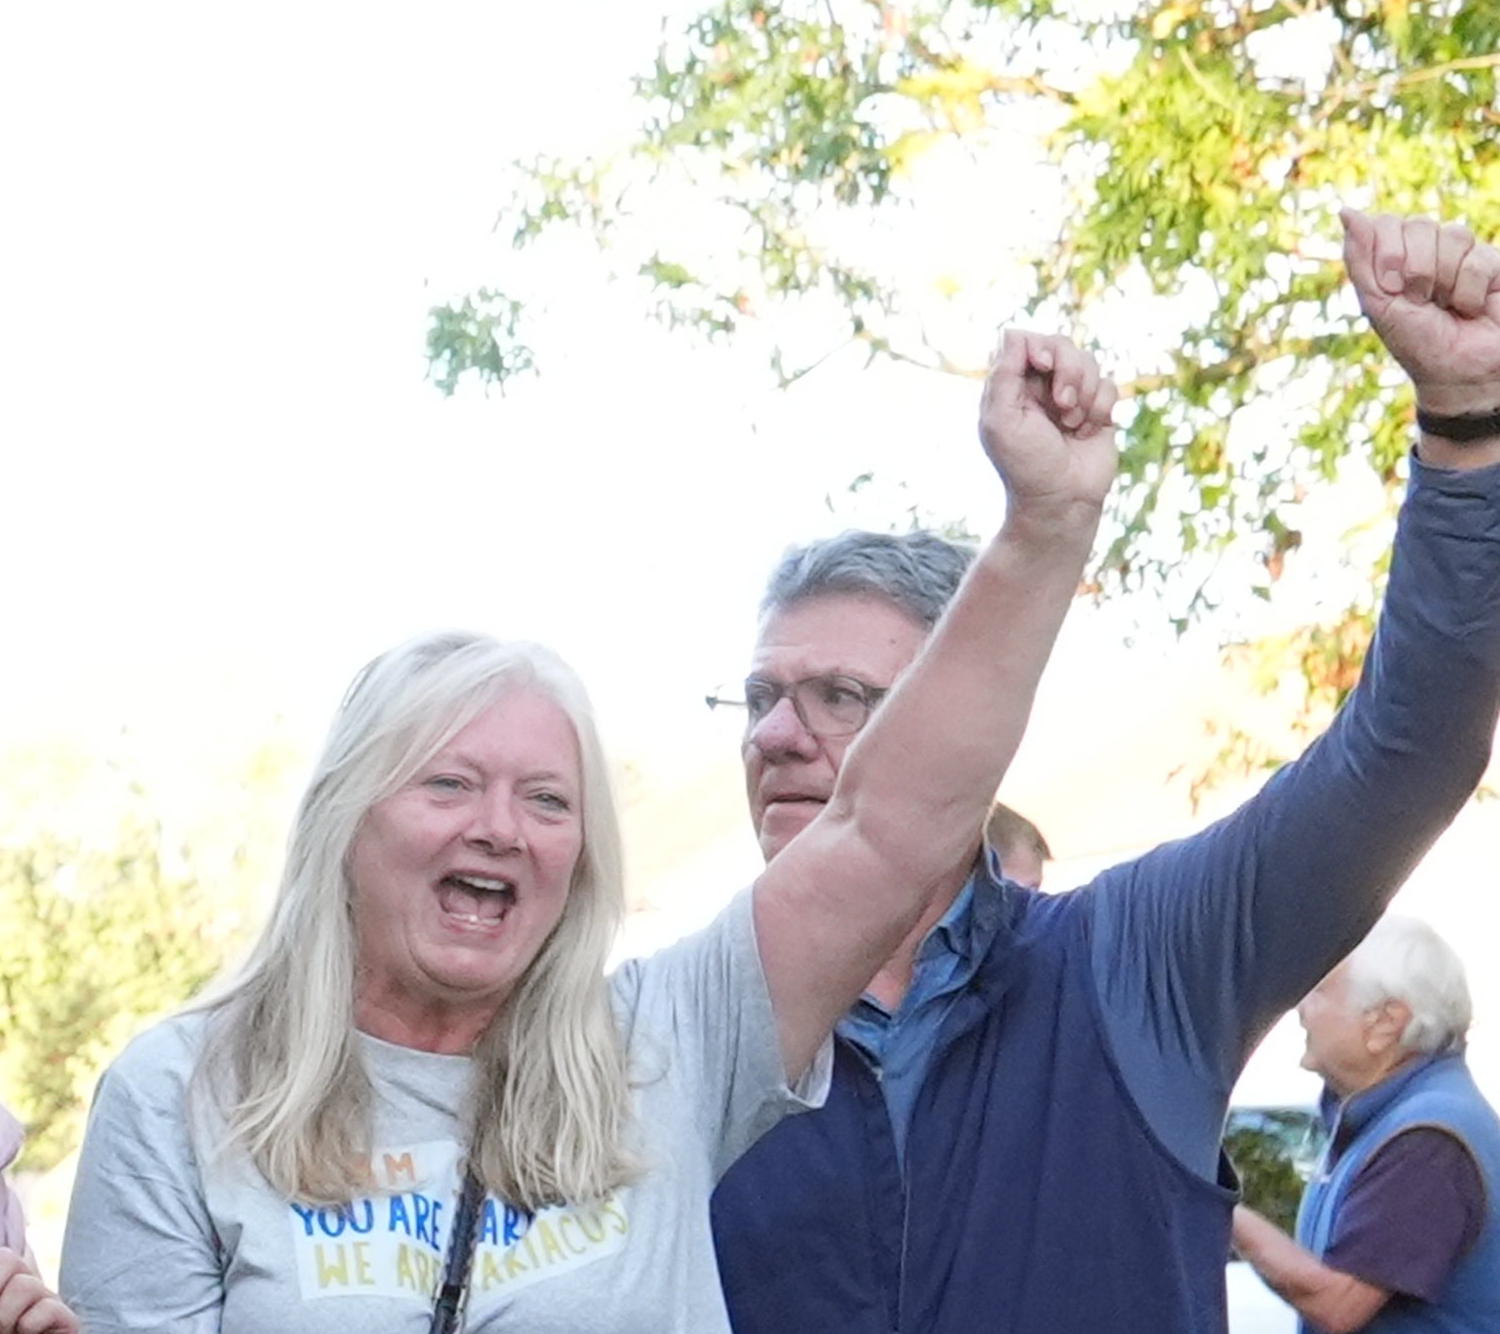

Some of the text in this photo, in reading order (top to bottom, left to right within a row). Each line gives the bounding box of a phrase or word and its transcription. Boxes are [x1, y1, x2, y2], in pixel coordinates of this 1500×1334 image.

[290, 1196, 374, 1238] YOU
[389, 1192, 443, 1252] ARE
[314, 1240, 375, 1289] WE
